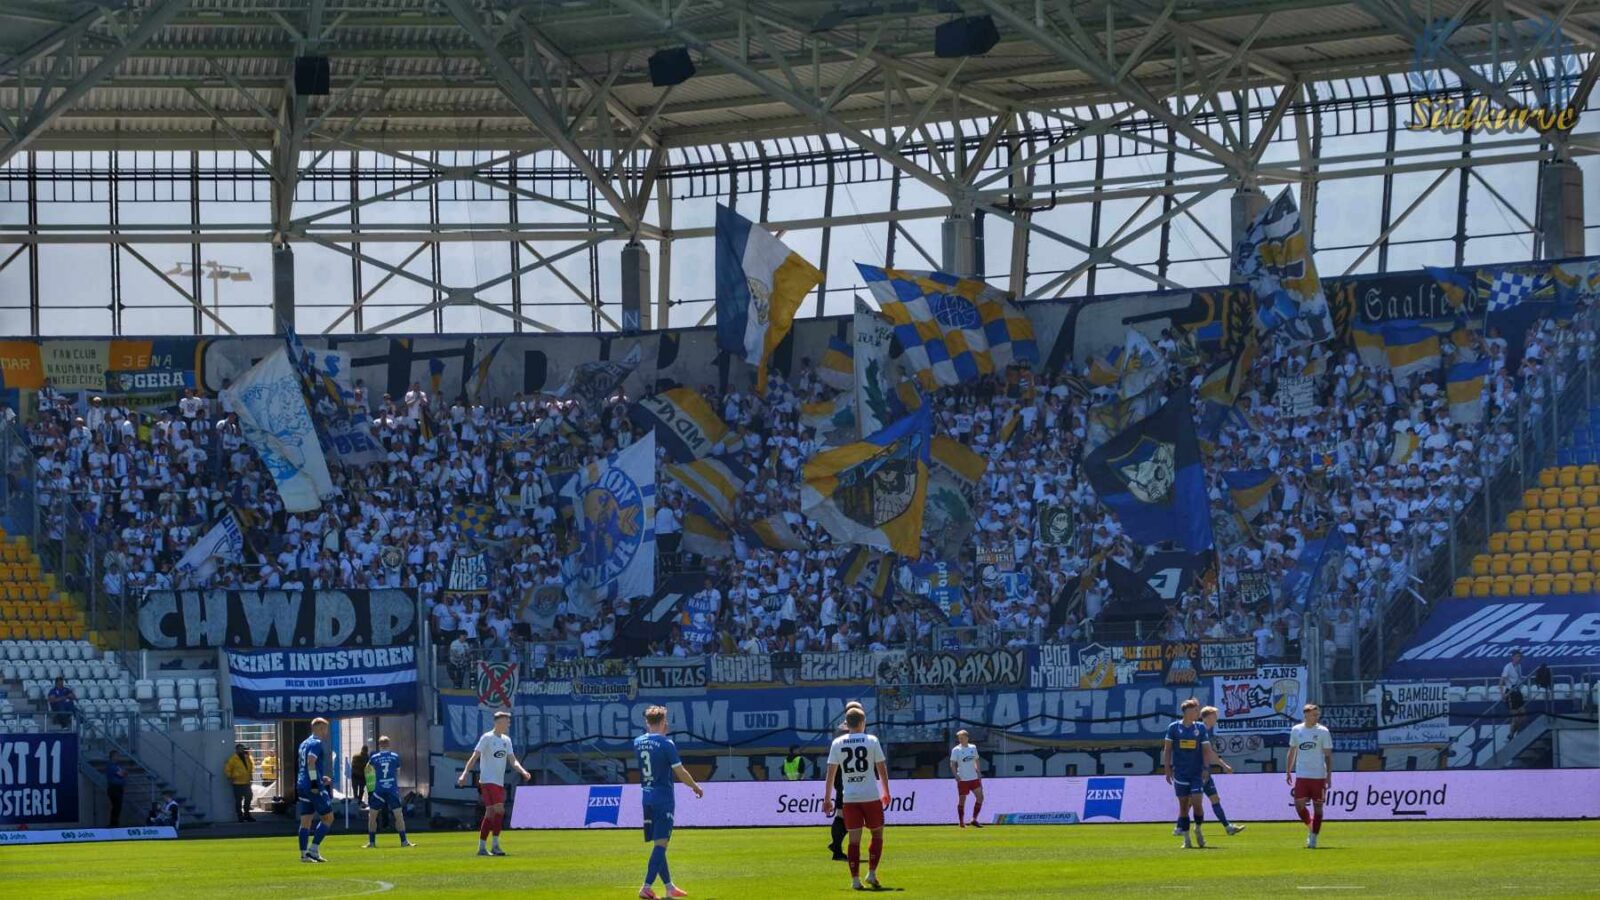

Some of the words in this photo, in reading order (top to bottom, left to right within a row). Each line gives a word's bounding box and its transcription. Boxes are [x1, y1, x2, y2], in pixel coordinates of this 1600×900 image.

[1364, 283, 1478, 321] Saalfed
[73, 348, 97, 359] CLUB
[122, 354, 172, 369] JENA
[134, 372, 185, 388] GERA
[1201, 642, 1256, 656] REFUGEES
[228, 652, 284, 672] KEINE
[289, 646, 415, 672] INVESTOREN
[1201, 657, 1256, 670] WELCOME
[306, 678, 325, 688] UND
[327, 676, 366, 687] ÜBERALL
[640, 665, 706, 687] ULTRAS
[1398, 686, 1448, 701] BAMBULE
[259, 697, 282, 714] IM
[289, 692, 393, 714] FUSSBALL
[1398, 703, 1448, 719] RANDALE
[1322, 706, 1376, 717] KUNFTS
[744, 712, 779, 729] UND
[1320, 717, 1374, 728] ONZEPT
[34, 740, 62, 784] 11
[640, 750, 652, 777] 3
[841, 746, 869, 773] 28
[380, 762, 390, 779] 7
[588, 795, 620, 807] ZEISS
[1086, 788, 1123, 800] ZEISS
[1365, 783, 1447, 813] beyond
